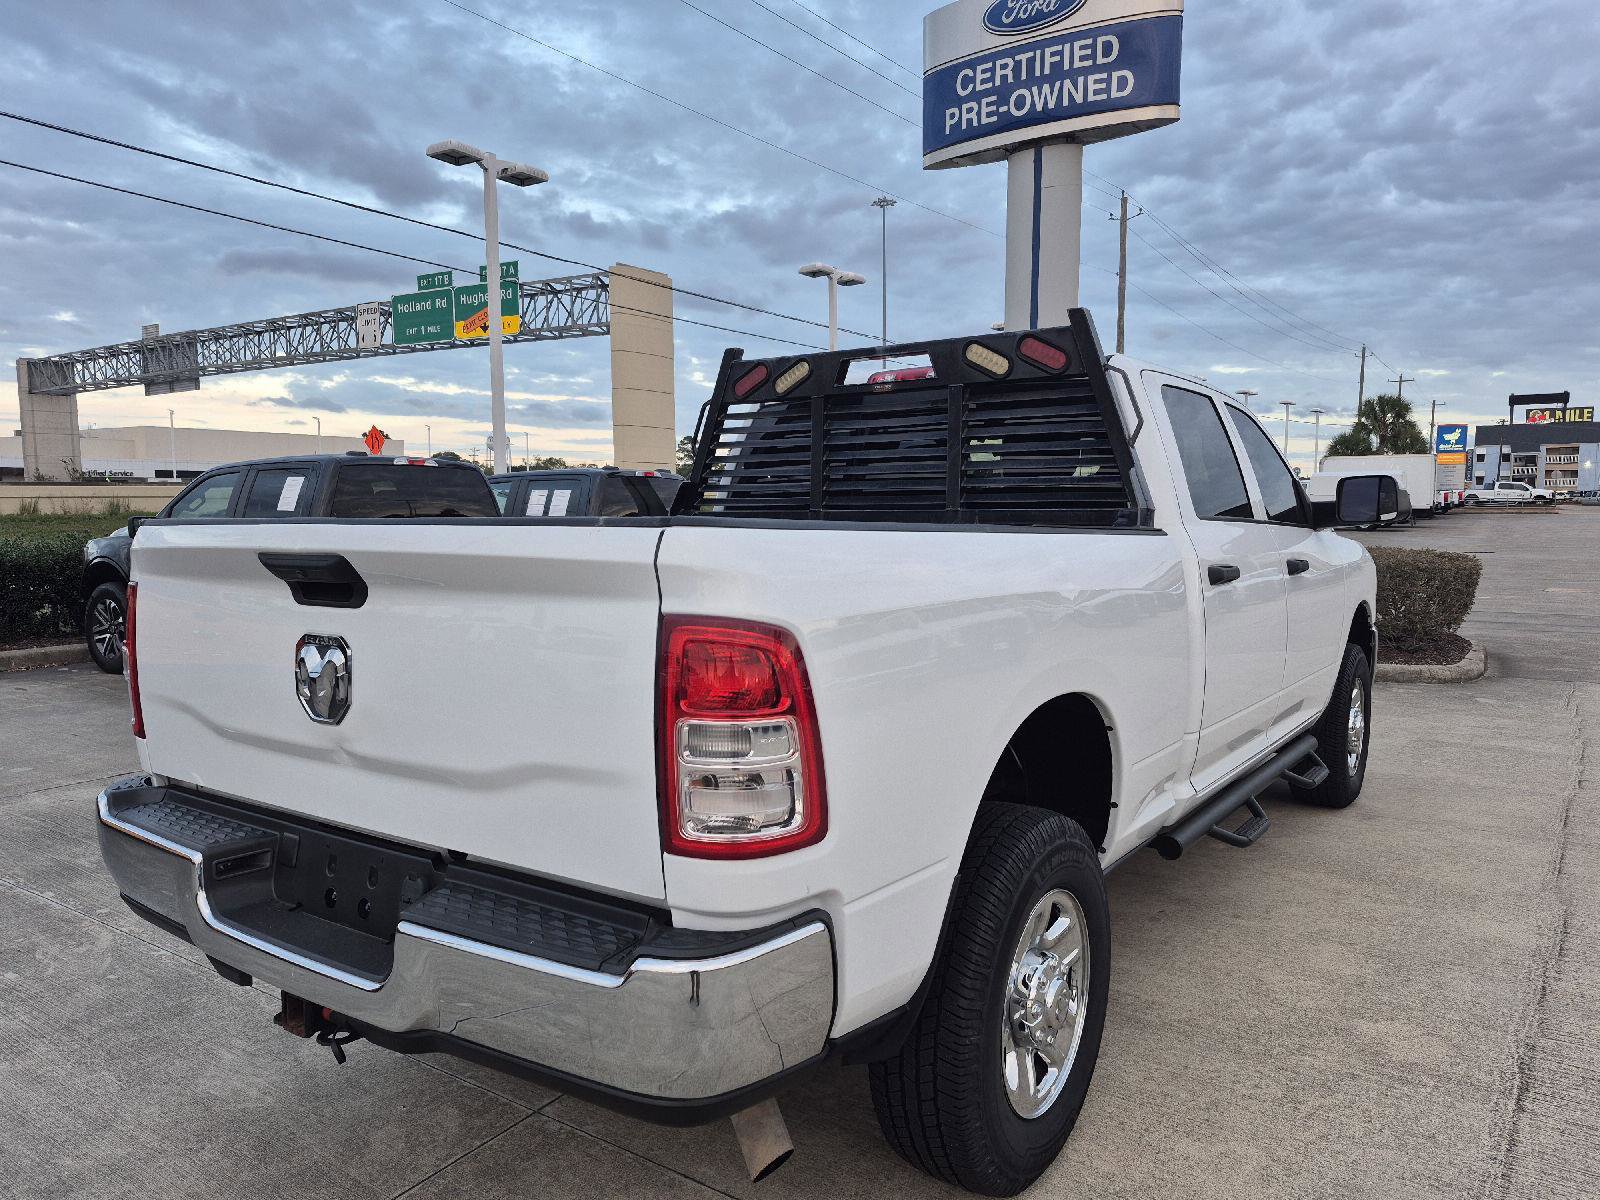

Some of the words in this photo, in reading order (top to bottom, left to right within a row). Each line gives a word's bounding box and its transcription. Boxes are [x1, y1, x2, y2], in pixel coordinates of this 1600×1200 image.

[1001, 0, 1061, 24] Ford
[956, 34, 1120, 97] CERTIFIED
[945, 69, 1135, 135] PRE-OWNED
[420, 278, 432, 287] EXIT
[460, 291, 488, 306] Hughe
[500, 287, 512, 299] Rd
[358, 307, 378, 316] SPEED
[398, 299, 431, 313] Holland
[436, 298, 447, 308] Rd
[361, 318, 376, 327] LIMIT
[406, 327, 418, 336] EXIT
[427, 324, 441, 334] MILE
[108, 469, 134, 477] Service
